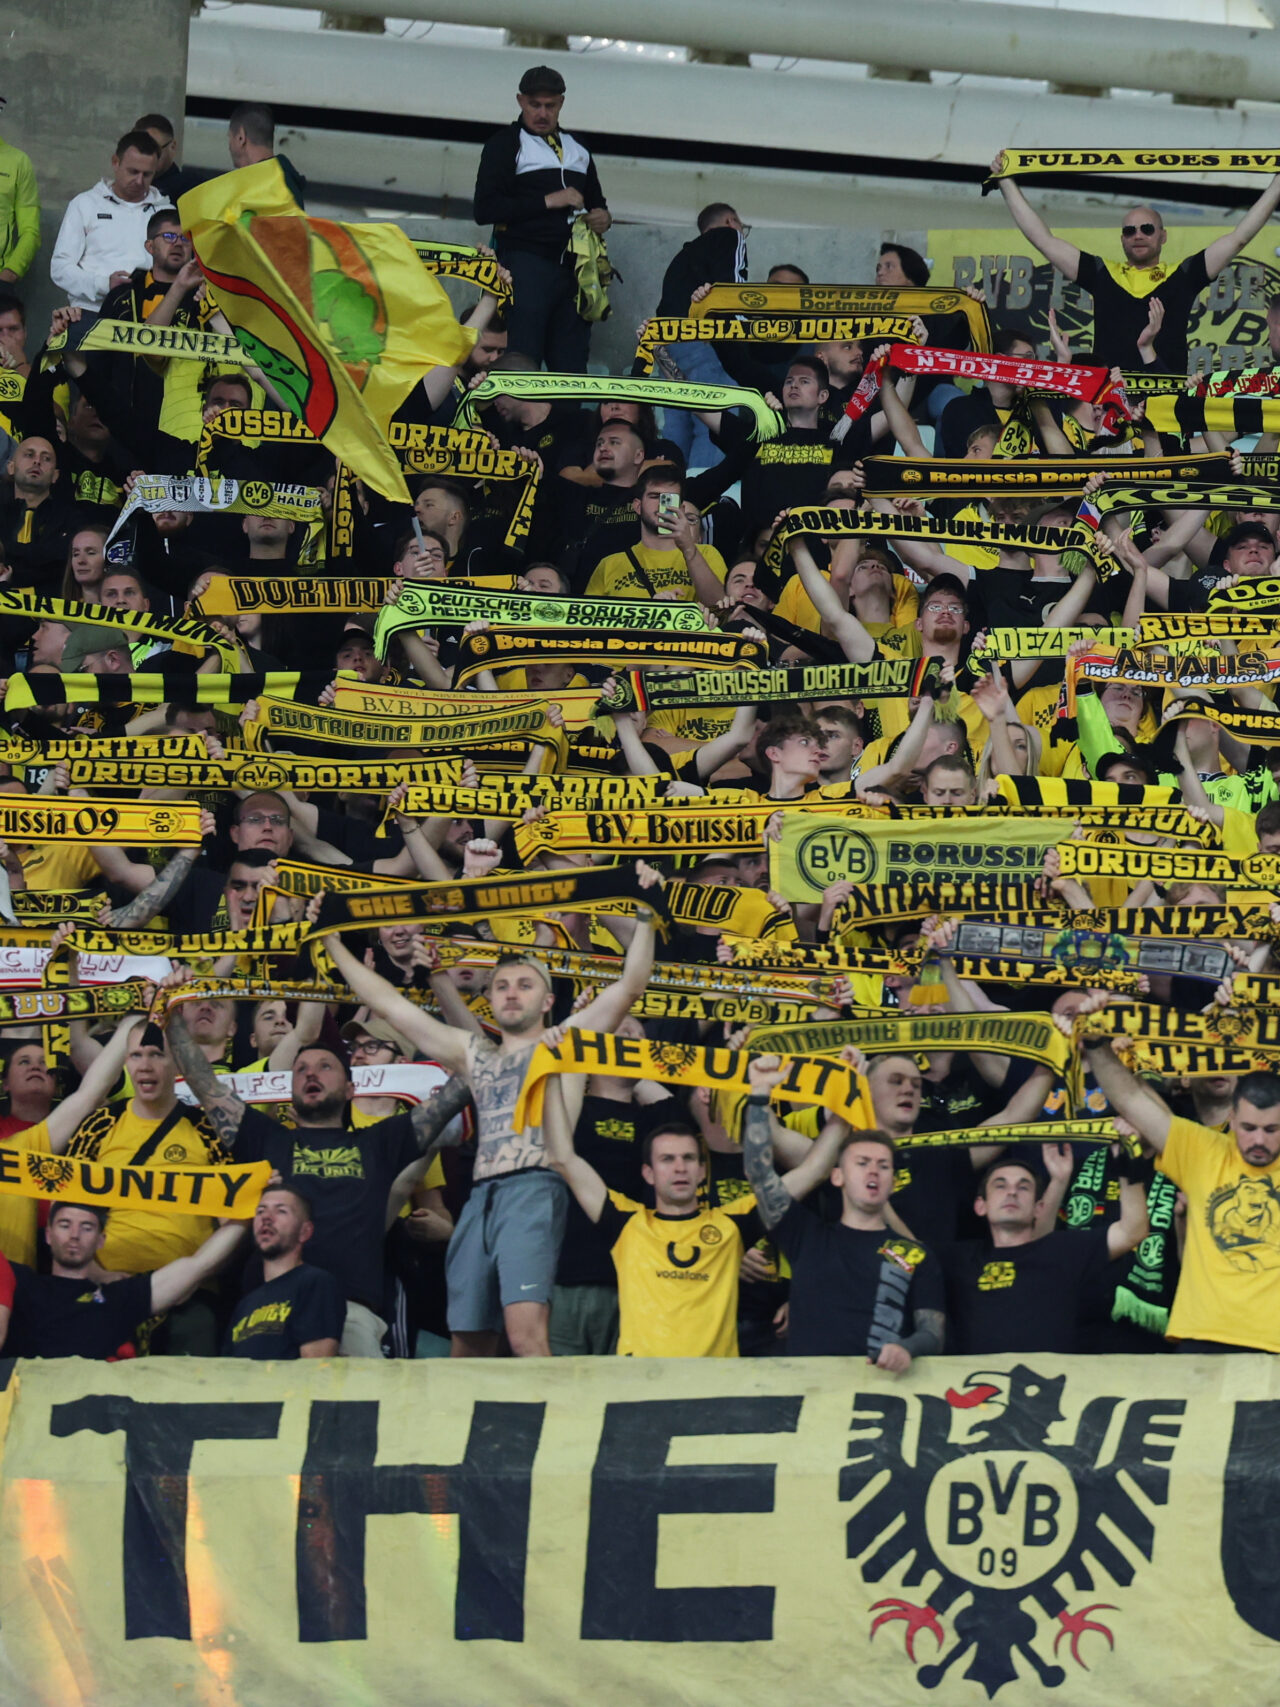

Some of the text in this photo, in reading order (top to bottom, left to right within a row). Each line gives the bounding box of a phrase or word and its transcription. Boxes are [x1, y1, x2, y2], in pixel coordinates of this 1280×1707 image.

[1017, 153, 1126, 168] FULDA
[1134, 154, 1220, 167] GOES
[800, 287, 900, 301] Borussia
[800, 299, 895, 312] Dortmund
[645, 318, 746, 341] RUSSIA
[801, 315, 914, 340] DORTMU
[207, 408, 313, 439] RUSSIA
[388, 421, 497, 451] ORTMU
[929, 467, 1172, 486] Borussia Dortmund
[246, 482, 270, 500] BVB
[277, 495, 321, 509] HALBF
[229, 577, 387, 612] DORTM
[428, 593, 533, 612] DEUTSCHER
[431, 605, 502, 620] MEISTER
[565, 616, 668, 631] DORTMUND
[567, 603, 673, 622] BORUSSIA
[1138, 616, 1269, 641] RUSSIA
[495, 633, 737, 658] Borussia Dortmund
[695, 660, 912, 697] BORUSSIA DORTMUND
[1178, 674, 1211, 690] get
[269, 705, 546, 743] SÜDTRIBÜNE DORTMUND
[46, 733, 208, 761] DORTMUN
[69, 759, 464, 791] ORUSSIA DORTMUN
[407, 784, 534, 816] RUSSIA
[5, 807, 120, 836] ussia 09
[586, 811, 758, 844] BV. Borussia
[811, 833, 868, 875] BVB
[886, 840, 1050, 867] BORUSSIA
[1059, 846, 1237, 878] BORUSSIA
[826, 870, 847, 882] 09
[1106, 905, 1263, 937] UNITY
[909, 1018, 1050, 1050] DORTMUND
[1103, 1002, 1206, 1039] THE
[703, 1047, 864, 1108] UITY
[80, 1160, 253, 1208] UNITY
[656, 1267, 710, 1283] vodafone
[48, 1394, 805, 1643] THE
[946, 1459, 1062, 1549] BVB
[976, 1546, 1019, 1577] 09
